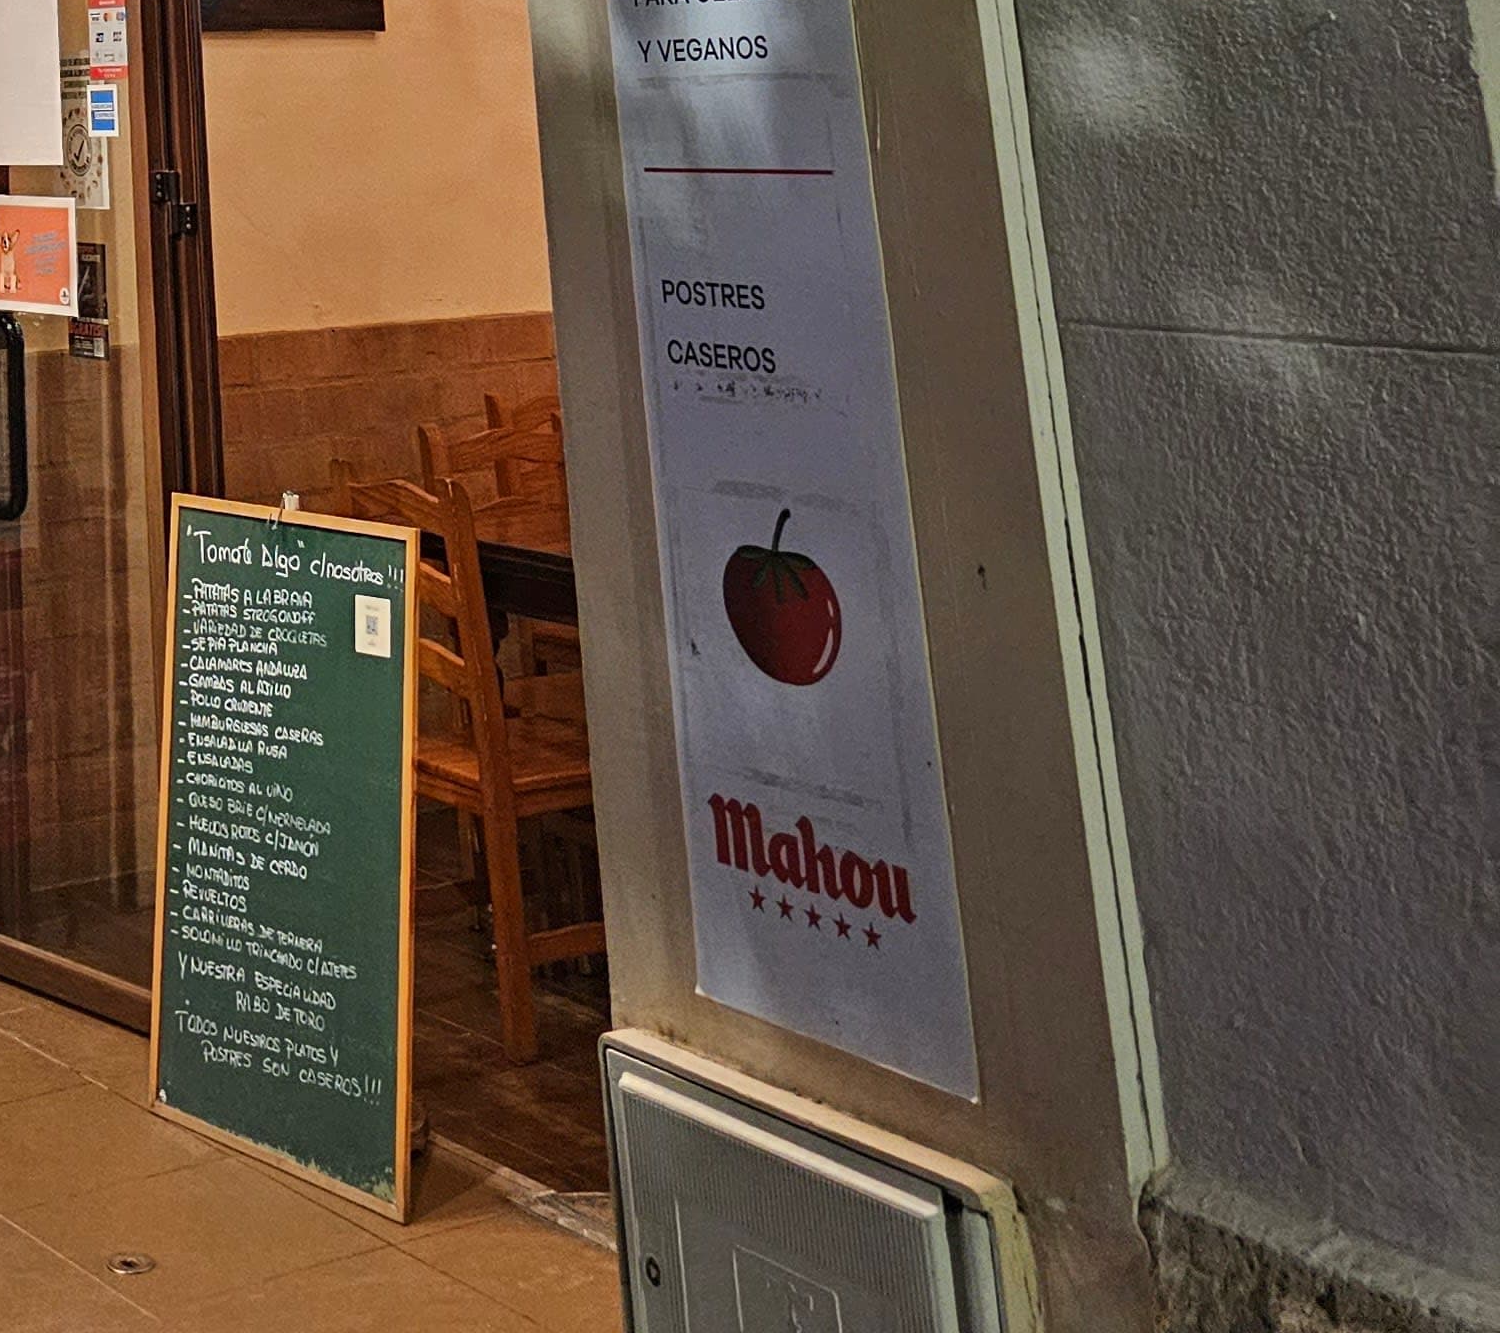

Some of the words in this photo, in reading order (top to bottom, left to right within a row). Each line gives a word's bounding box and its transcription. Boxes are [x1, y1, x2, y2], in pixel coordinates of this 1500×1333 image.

[637, 40, 652, 64] Y
[657, 35, 770, 64] VEGANOS
[661, 277, 766, 311] POSTRES
[667, 338, 777, 374] CASEROS
[191, 577, 240, 605] PATATAS
[243, 589, 252, 607] A
[256, 588, 272, 606] LA
[191, 599, 238, 619] PATATAS
[250, 625, 263, 639] DE
[189, 655, 253, 673] CALAMARES
[188, 673, 235, 693] GAMBAS
[240, 680, 255, 695] AL
[190, 689, 221, 710] POLLO
[190, 712, 269, 737] HAMBURGUESAS
[274, 726, 324, 747] CASERAS
[187, 751, 254, 774] ENSALADAS
[257, 740, 288, 759] RUSA
[188, 791, 223, 811] QUESO
[249, 783, 263, 796] AL
[188, 814, 229, 839] HUEVOS
[230, 824, 261, 843] ROTOS
[250, 853, 265, 871] DE
[269, 859, 308, 880] CERDO
[707, 792, 917, 925] Mahou
[182, 879, 247, 913] REVUELTOS
[259, 924, 275, 941] DE
[276, 930, 323, 954] TERNERA
[178, 950, 188, 980] Y
[190, 955, 246, 983] NUESTRA
[235, 990, 270, 1014] RABO
[275, 1003, 291, 1021] DE
[292, 1007, 325, 1032] TORO
[200, 1039, 253, 1068] POSTRES
[263, 1057, 290, 1077] SON
[223, 1025, 281, 1053] NUESTROS
[284, 1037, 327, 1064] PLATOS
[330, 1045, 339, 1067] Y
